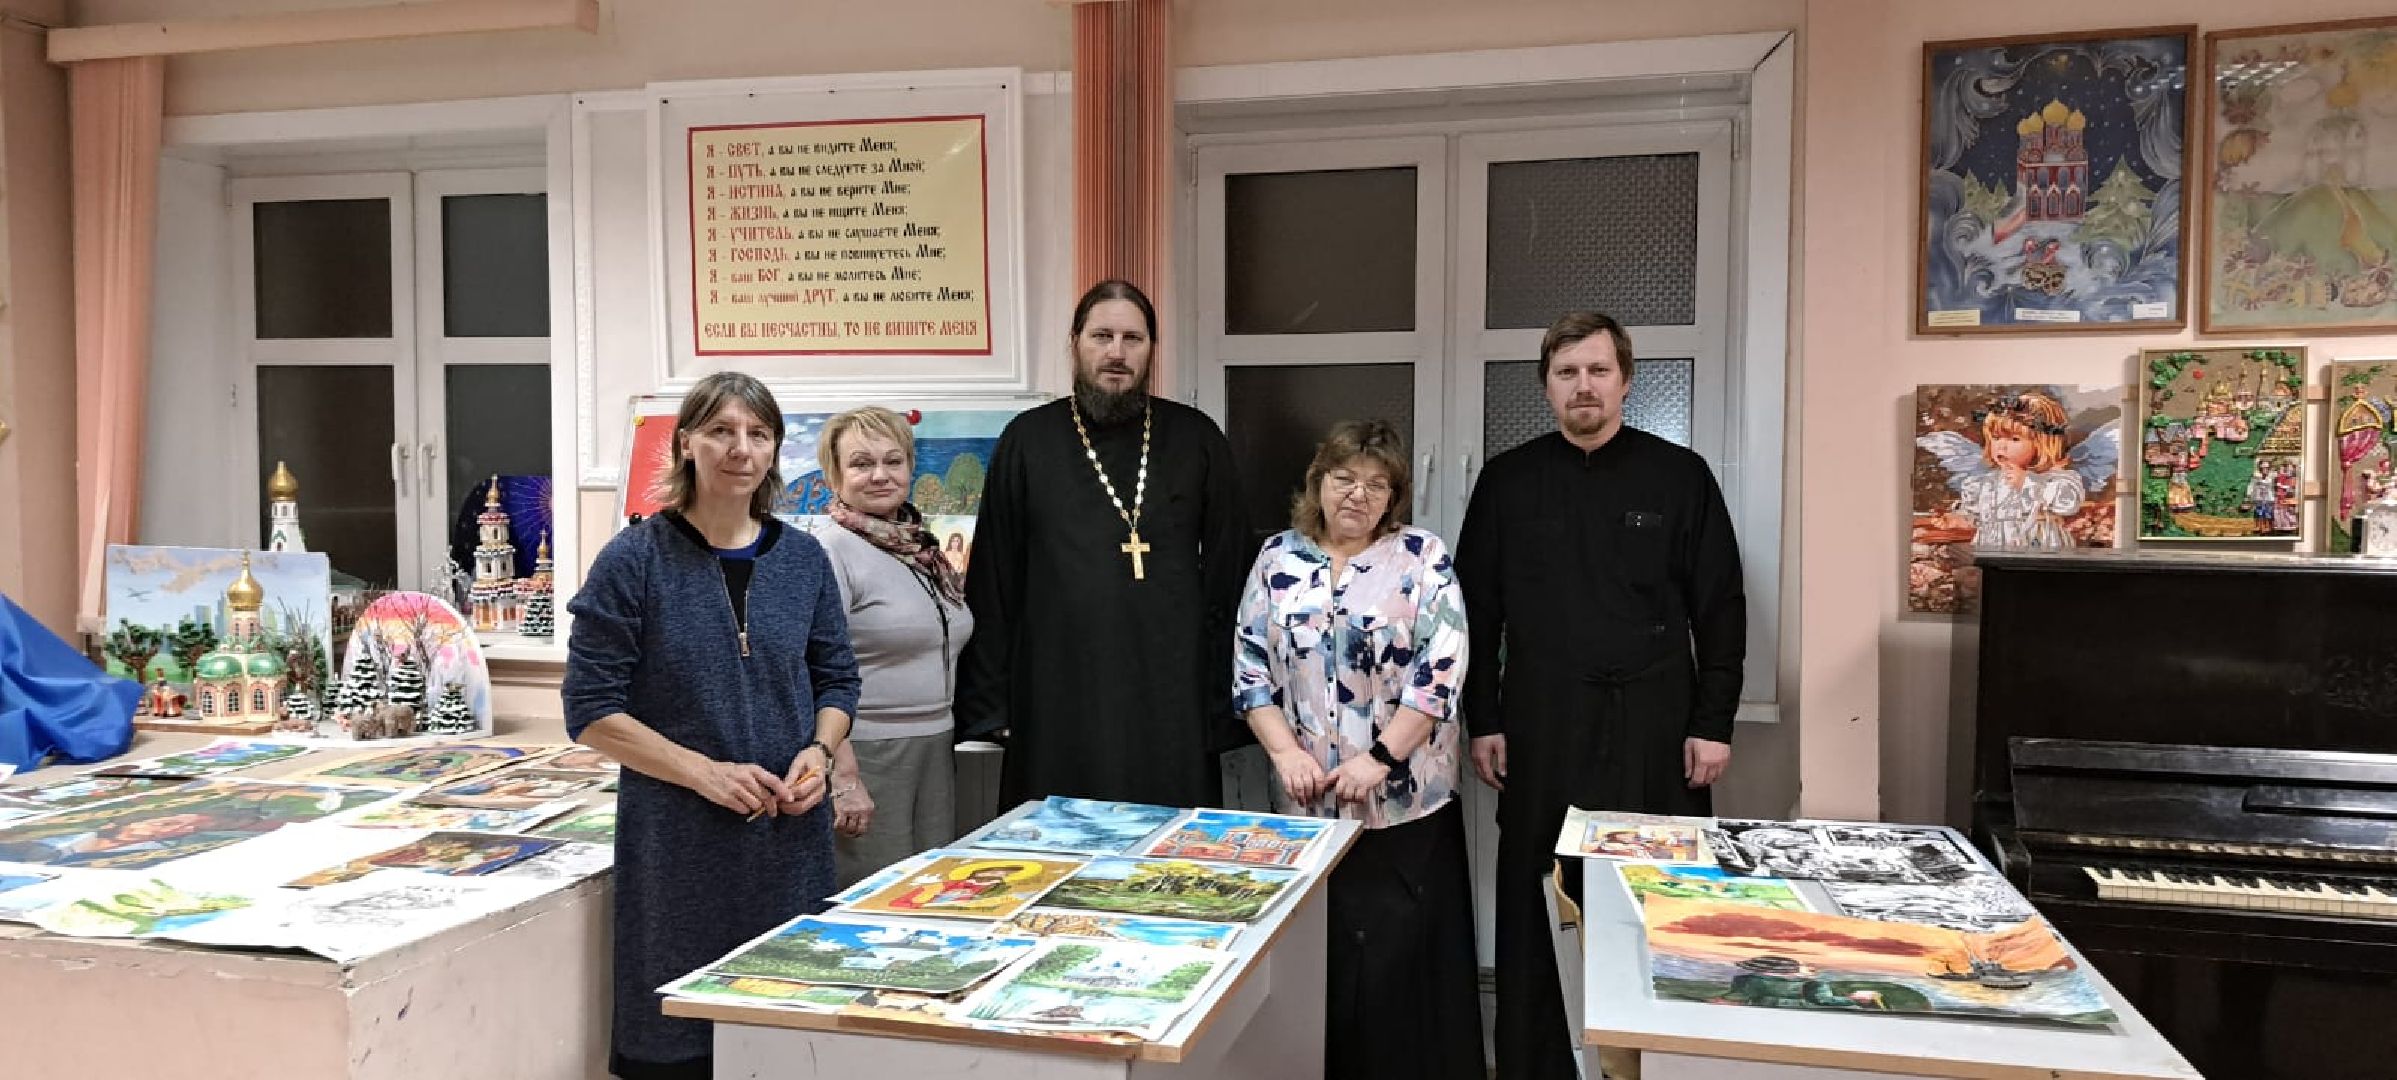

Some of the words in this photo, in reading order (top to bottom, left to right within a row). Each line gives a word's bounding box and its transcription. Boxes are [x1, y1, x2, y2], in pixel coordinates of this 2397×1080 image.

[707, 144, 715, 158] Я
[778, 145, 793, 155] вы
[797, 144, 810, 154] не
[707, 165, 715, 179] Я
[779, 166, 795, 176] вы
[798, 166, 811, 175] не
[707, 186, 715, 200] Я
[800, 187, 815, 197] вы
[819, 186, 832, 196] не
[707, 207, 716, 221] Я
[793, 208, 808, 218] вы
[812, 208, 825, 218] не
[707, 228, 717, 242] Я
[807, 229, 824, 239] вы
[827, 228, 841, 239] не
[707, 248, 717, 263] Я
[804, 250, 820, 261] вы
[824, 250, 838, 261] не
[709, 269, 718, 284] Я
[797, 271, 814, 281] вы
[816, 271, 831, 281] не
[710, 290, 718, 304] Я
[852, 292, 869, 302] вы
[873, 292, 887, 302] не
